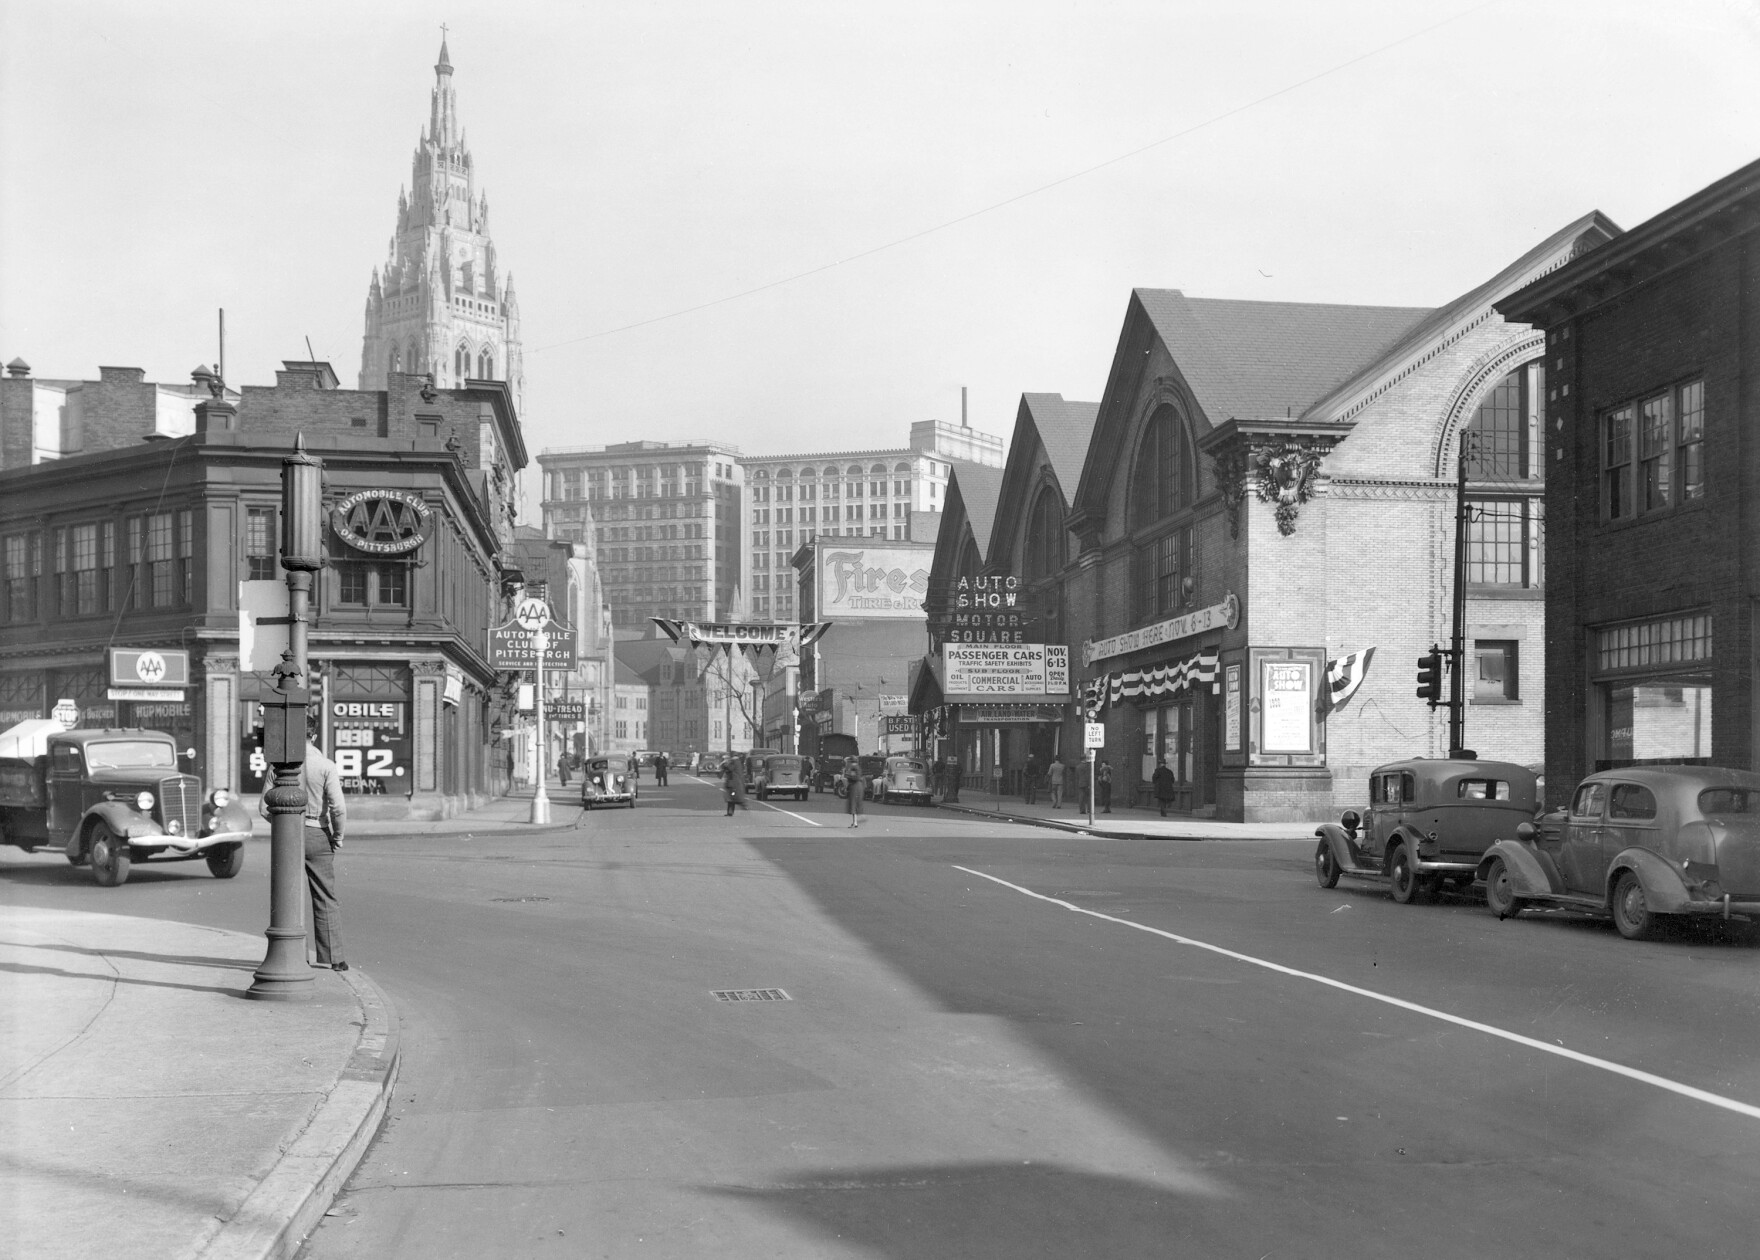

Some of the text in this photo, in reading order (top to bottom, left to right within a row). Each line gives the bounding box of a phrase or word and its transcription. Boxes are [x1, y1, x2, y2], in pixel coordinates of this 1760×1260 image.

[338, 489, 430, 517] AUTOMOBILE CLUB
[347, 499, 420, 541] AAA
[340, 528, 424, 553] OF PITTSBURGH
[957, 575, 1018, 590] AUTO
[849, 596, 892, 609] TIRE
[958, 593, 1017, 607] SHOW
[519, 603, 548, 624] AAA
[956, 614, 1020, 627] MOTOR
[496, 631, 571, 640] AUTOMBILE
[700, 625, 788, 641] WELCOME
[951, 630, 1023, 643] SQUARE
[1142, 625, 1164, 646] HERE
[948, 650, 1043, 660] PASSENGER CARS
[1047, 647, 1067, 657] NOV.
[140, 658, 163, 676] AAA
[971, 677, 1020, 685] COMMERCIAL
[1273, 670, 1300, 681] AUTO
[1274, 680, 1303, 690] SHOW
[54, 709, 78, 722] STOP
[136, 704, 191, 718] HUPMOBILE
[888, 724, 910, 732] USED
